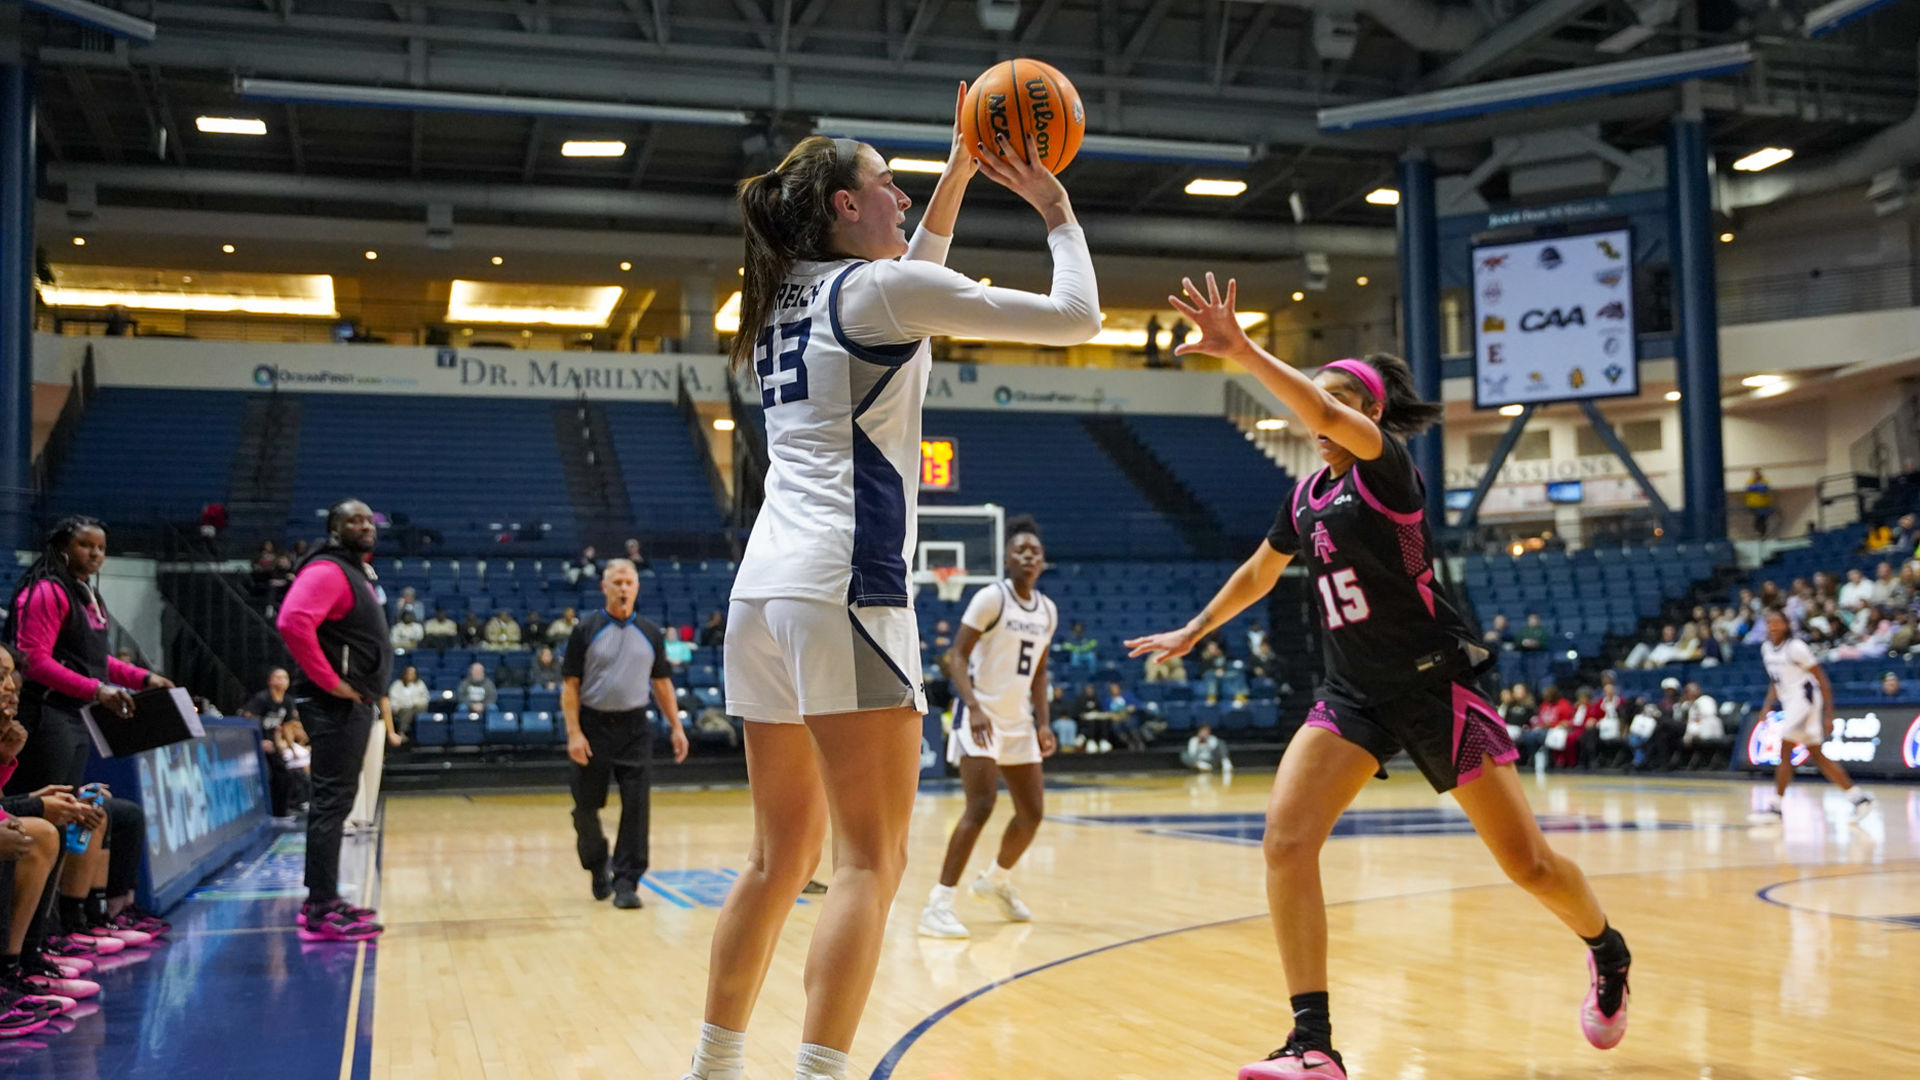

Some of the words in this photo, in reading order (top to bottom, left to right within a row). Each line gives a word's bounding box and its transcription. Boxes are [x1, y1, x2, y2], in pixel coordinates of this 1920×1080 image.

[990, 93, 1011, 156] NCA
[1025, 77, 1054, 159] Wilson
[1519, 303, 1586, 333] CAA
[529, 358, 671, 392] MARILYN
[755, 317, 813, 410] 23
[921, 458, 951, 487] 13
[1317, 566, 1372, 631] 15
[1016, 639, 1035, 677] 6
